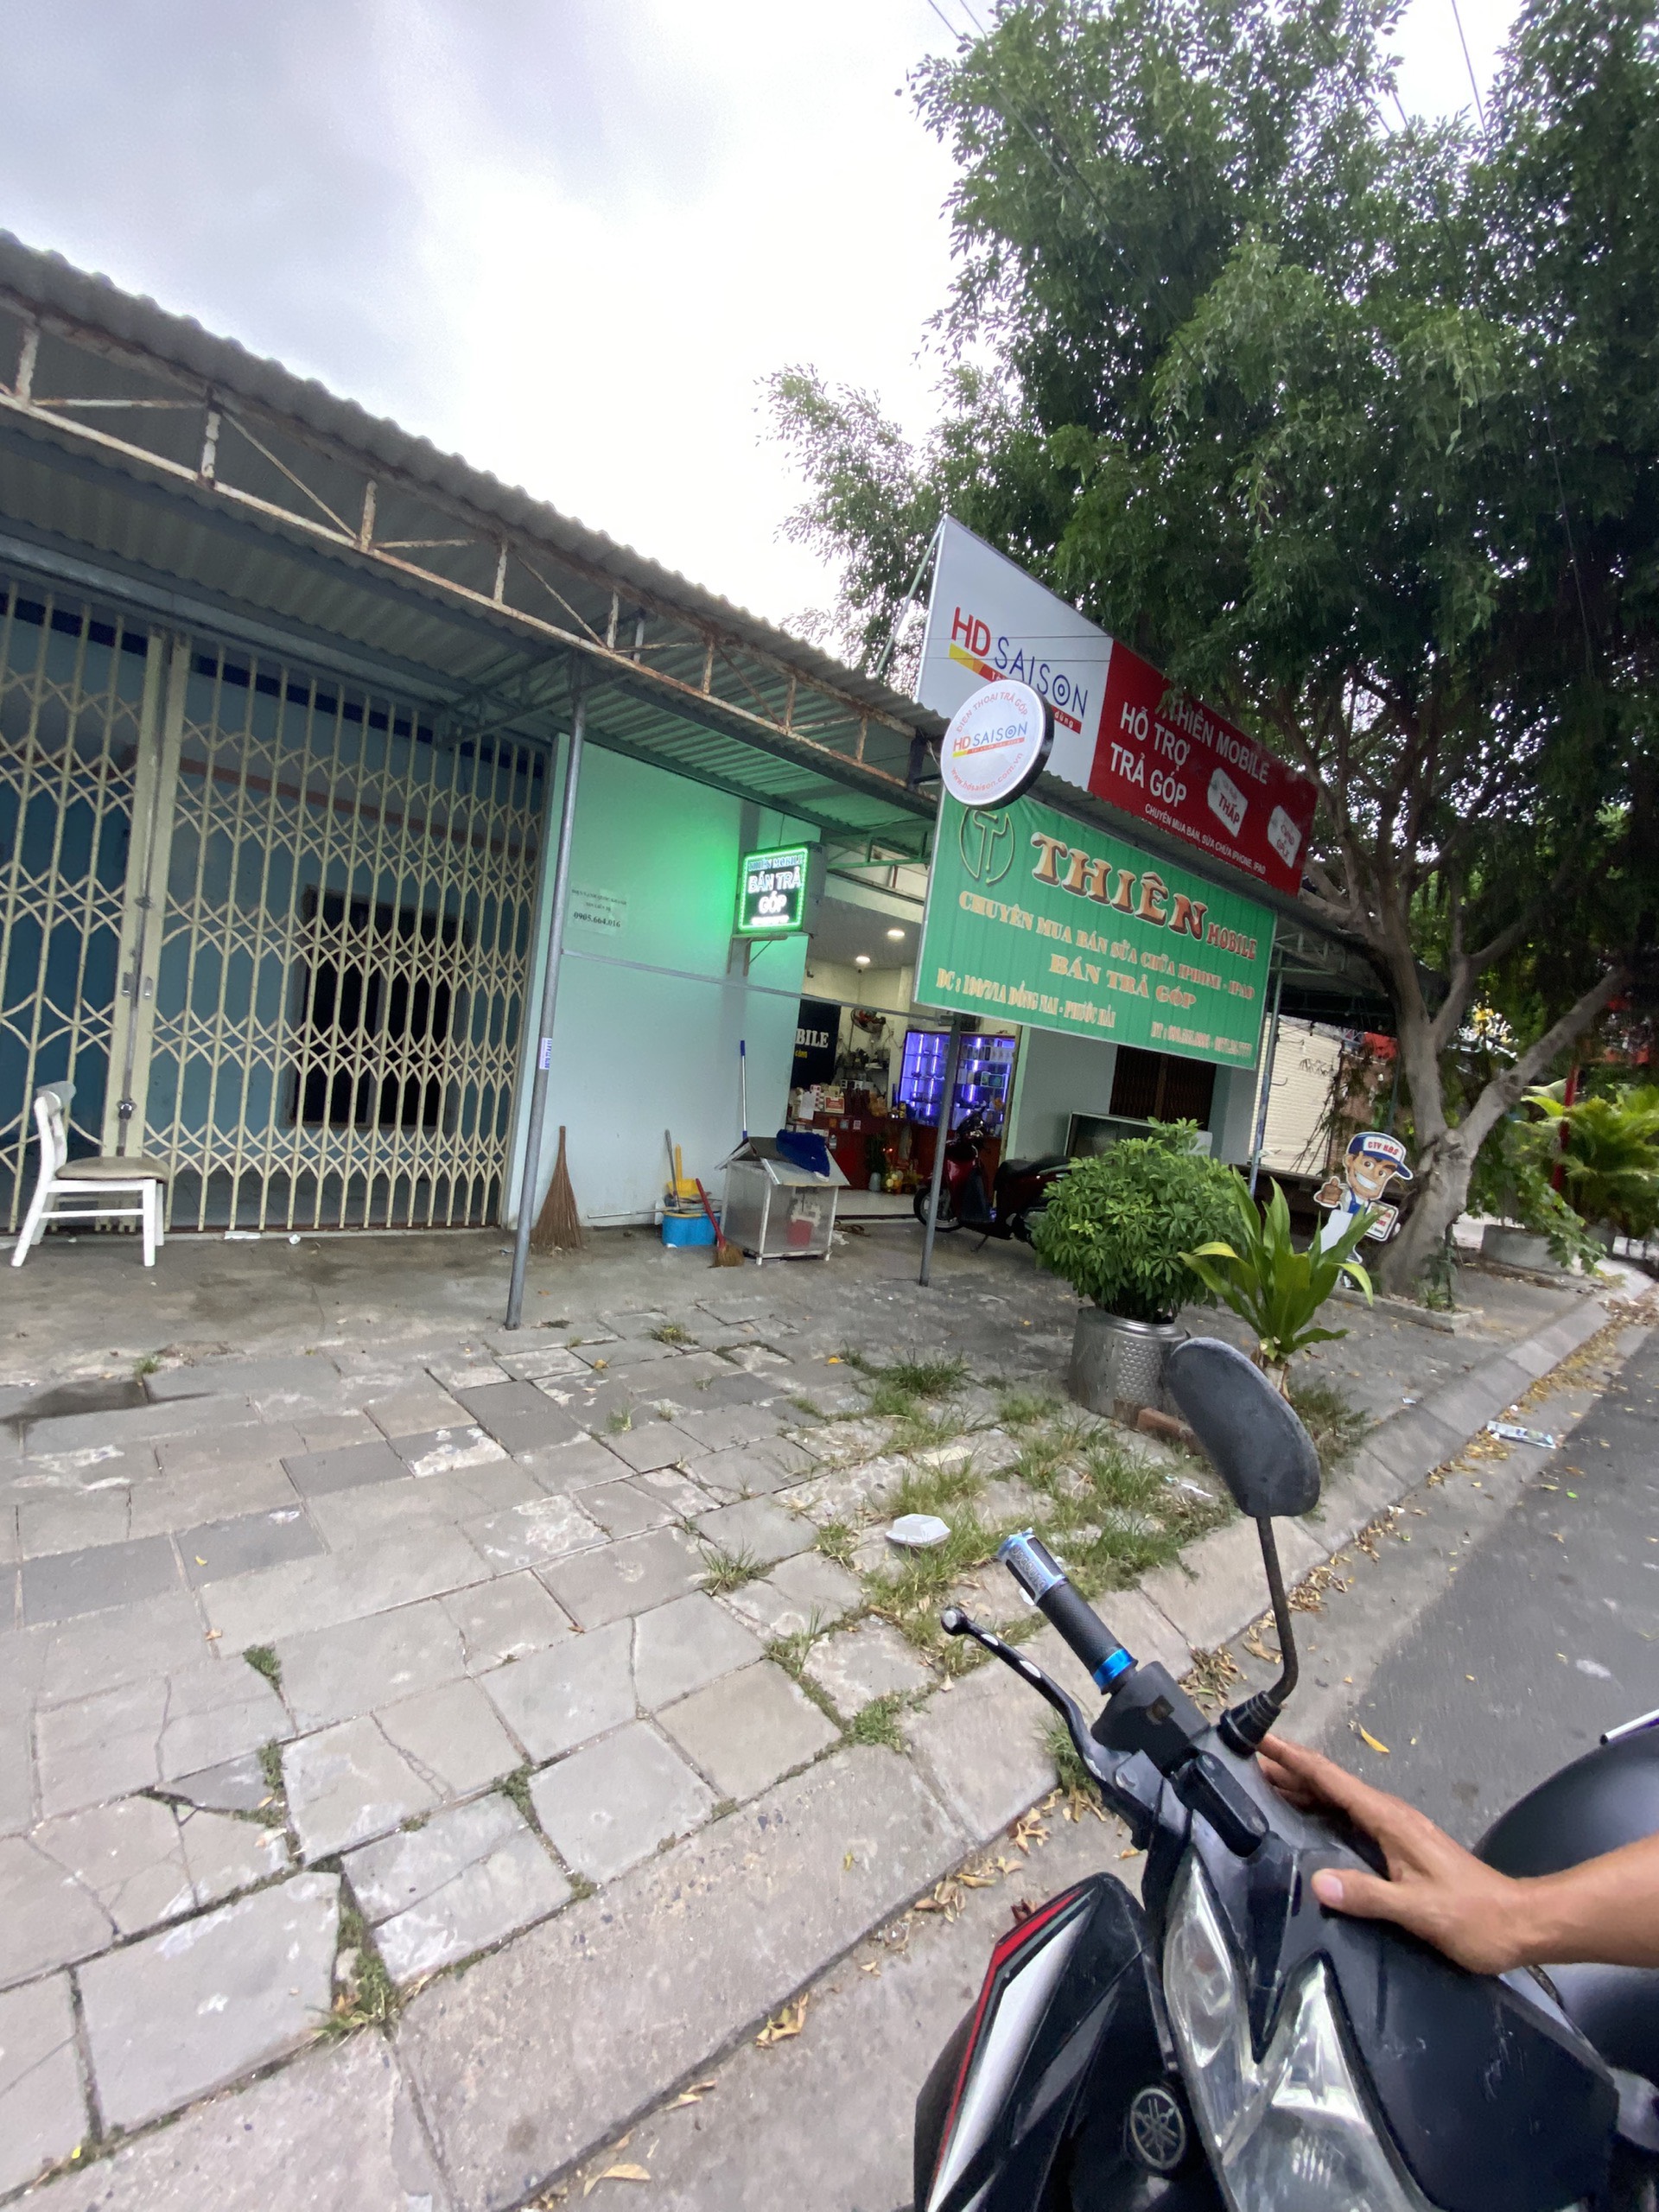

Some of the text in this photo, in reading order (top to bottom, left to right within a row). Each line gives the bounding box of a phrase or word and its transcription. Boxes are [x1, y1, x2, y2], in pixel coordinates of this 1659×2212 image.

[951, 607, 1088, 718] HD SAISON
[953, 736, 971, 751] HD
[972, 721, 1028, 747] SAISON
[1120, 702, 1192, 772] HỖ TRỢ
[1168, 696, 1270, 785] HIÊN MOBILE
[950, 752, 1023, 791] www.hdsaison.com.vn
[1110, 741, 1146, 789] TRẢ
[1149, 769, 1187, 808] GÓP
[747, 866, 802, 894] BÁN TRẢ
[1030, 831, 1258, 961] THIÊN MOBILE
[959, 890, 1034, 931] CHUYÊN
[1036, 917, 1072, 944] MUA
[1076, 929, 1109, 956] BÁN
[1049, 953, 1197, 1009] BÁN TRẢ GÓP
